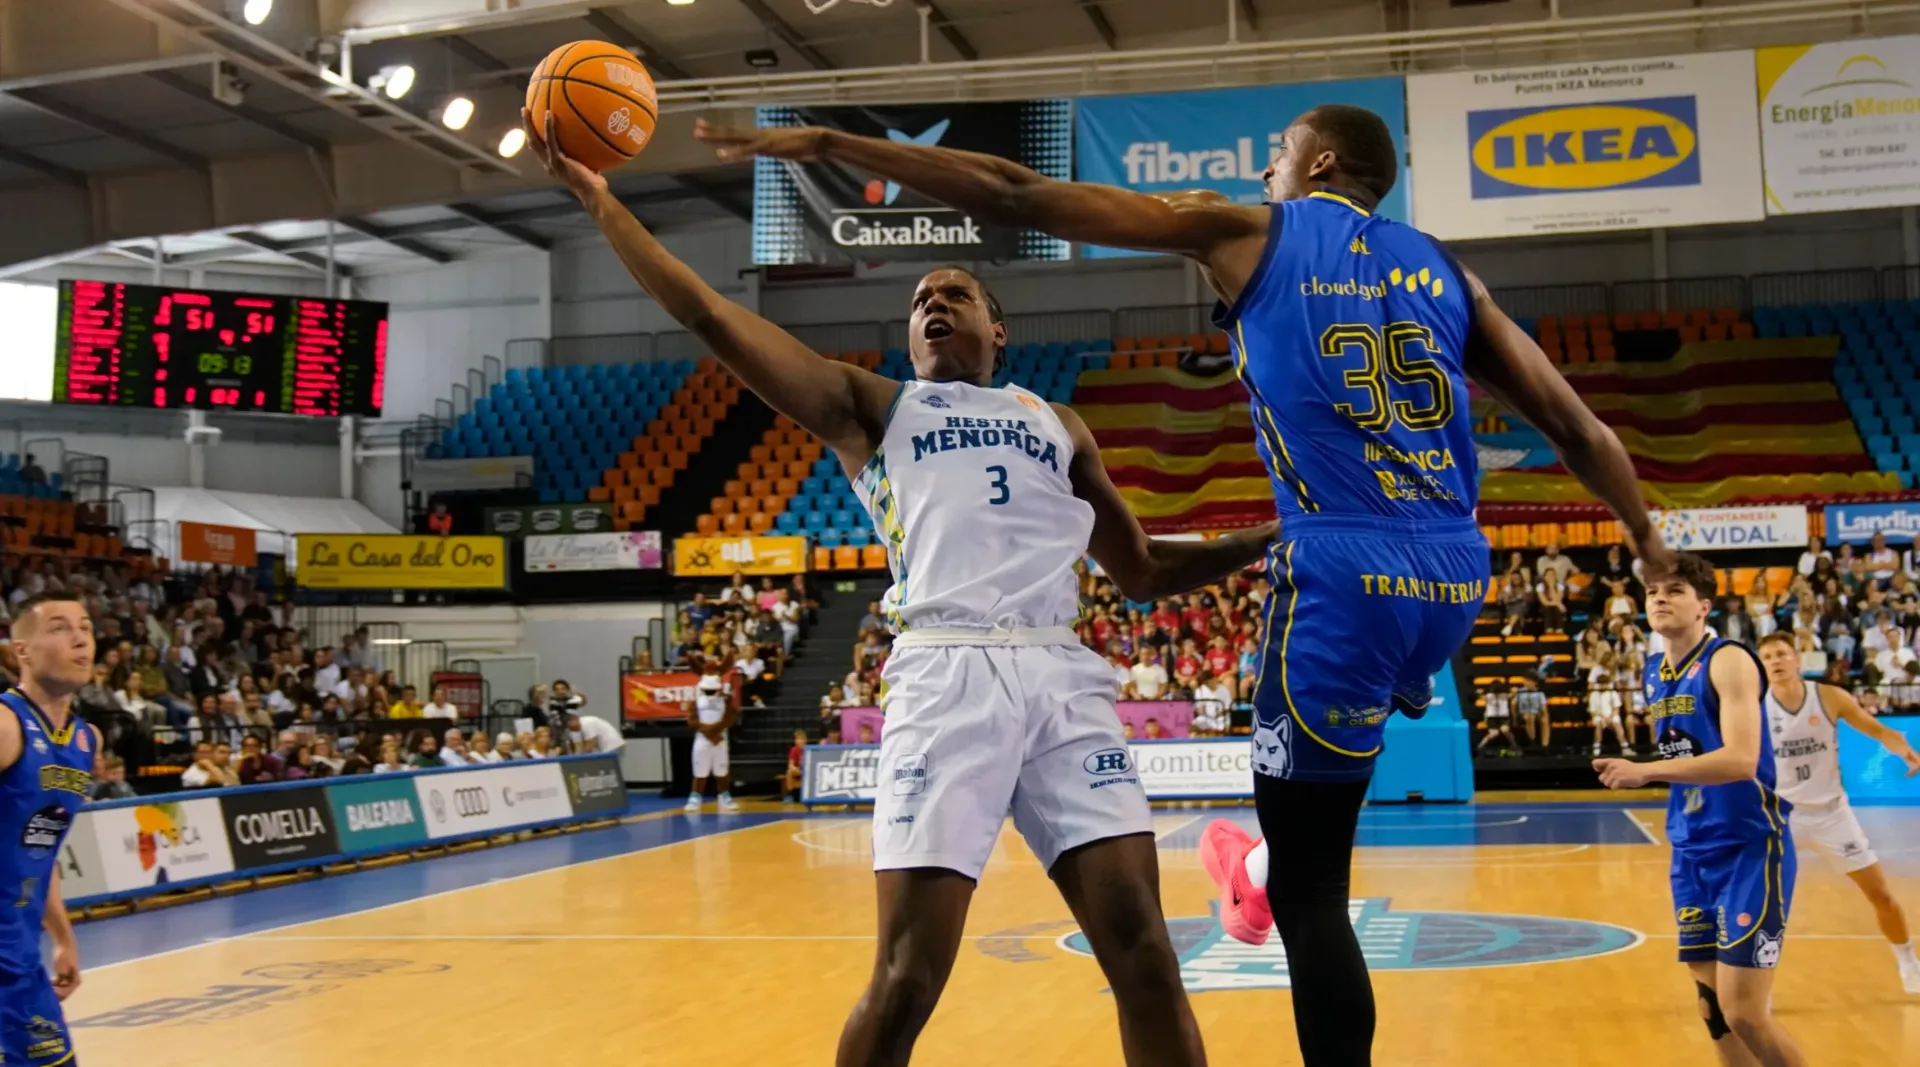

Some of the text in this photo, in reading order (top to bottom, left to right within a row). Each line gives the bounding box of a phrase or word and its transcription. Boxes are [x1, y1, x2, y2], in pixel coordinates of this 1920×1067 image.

[1491, 69, 1556, 82] baloncesto
[1560, 66, 1589, 78] cada
[1592, 63, 1629, 75] Punto
[1515, 76, 1643, 94] Punto IKEA Menorca
[1123, 132, 1283, 184] fibraLi
[1492, 124, 1680, 170] IKEA
[831, 216, 982, 246] CaixaBank
[1320, 321, 1453, 434] 35
[945, 416, 1030, 433] HESTIA
[911, 429, 1059, 473] MENORCA
[985, 464, 1011, 505] 3
[1700, 524, 1778, 545] VIDAL
[307, 540, 495, 567] La Casa del Oro
[1096, 753, 1127, 772] HR
[1134, 749, 1248, 774] Lomitec
[819, 764, 878, 792] MEN
[235, 806, 326, 845] COMELLA
